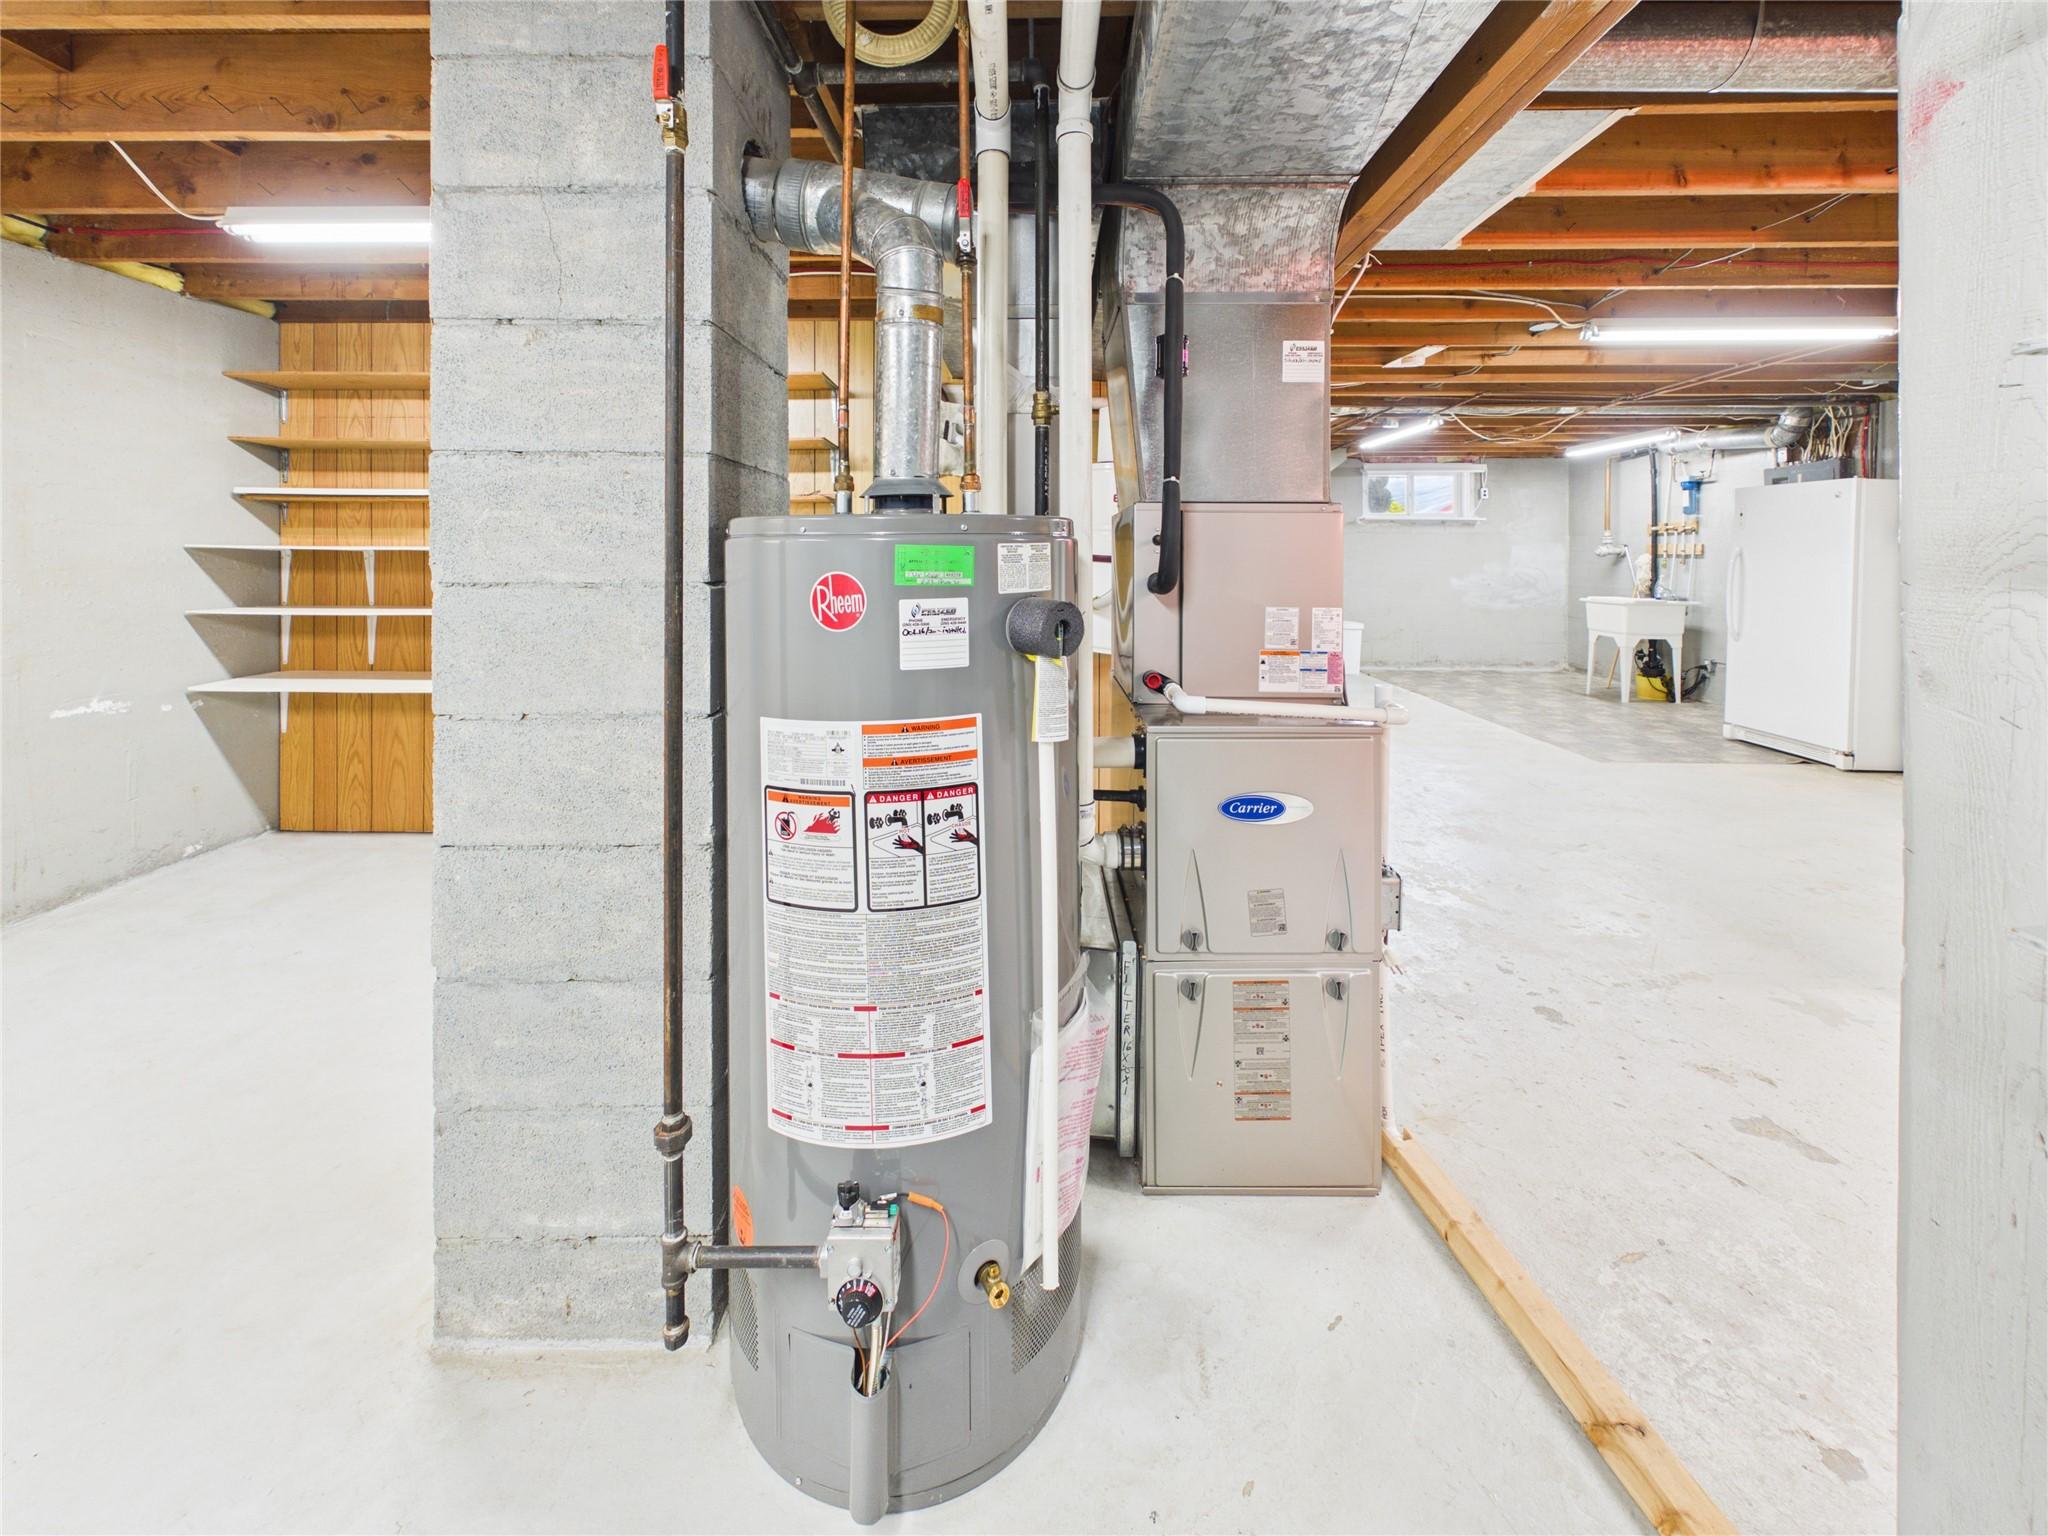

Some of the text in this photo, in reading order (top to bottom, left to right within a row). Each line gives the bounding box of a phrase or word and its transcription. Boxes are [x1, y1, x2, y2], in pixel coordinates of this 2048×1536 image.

[816, 575, 864, 622] Rheem
[911, 723, 940, 732] WARNING
[900, 756, 952, 765] AVERTISSEMENT
[879, 793, 919, 802] DANGER
[937, 787, 974, 798] DANGER
[1229, 802, 1277, 814] Carrier
[1123, 960, 1133, 1037] FILTER
